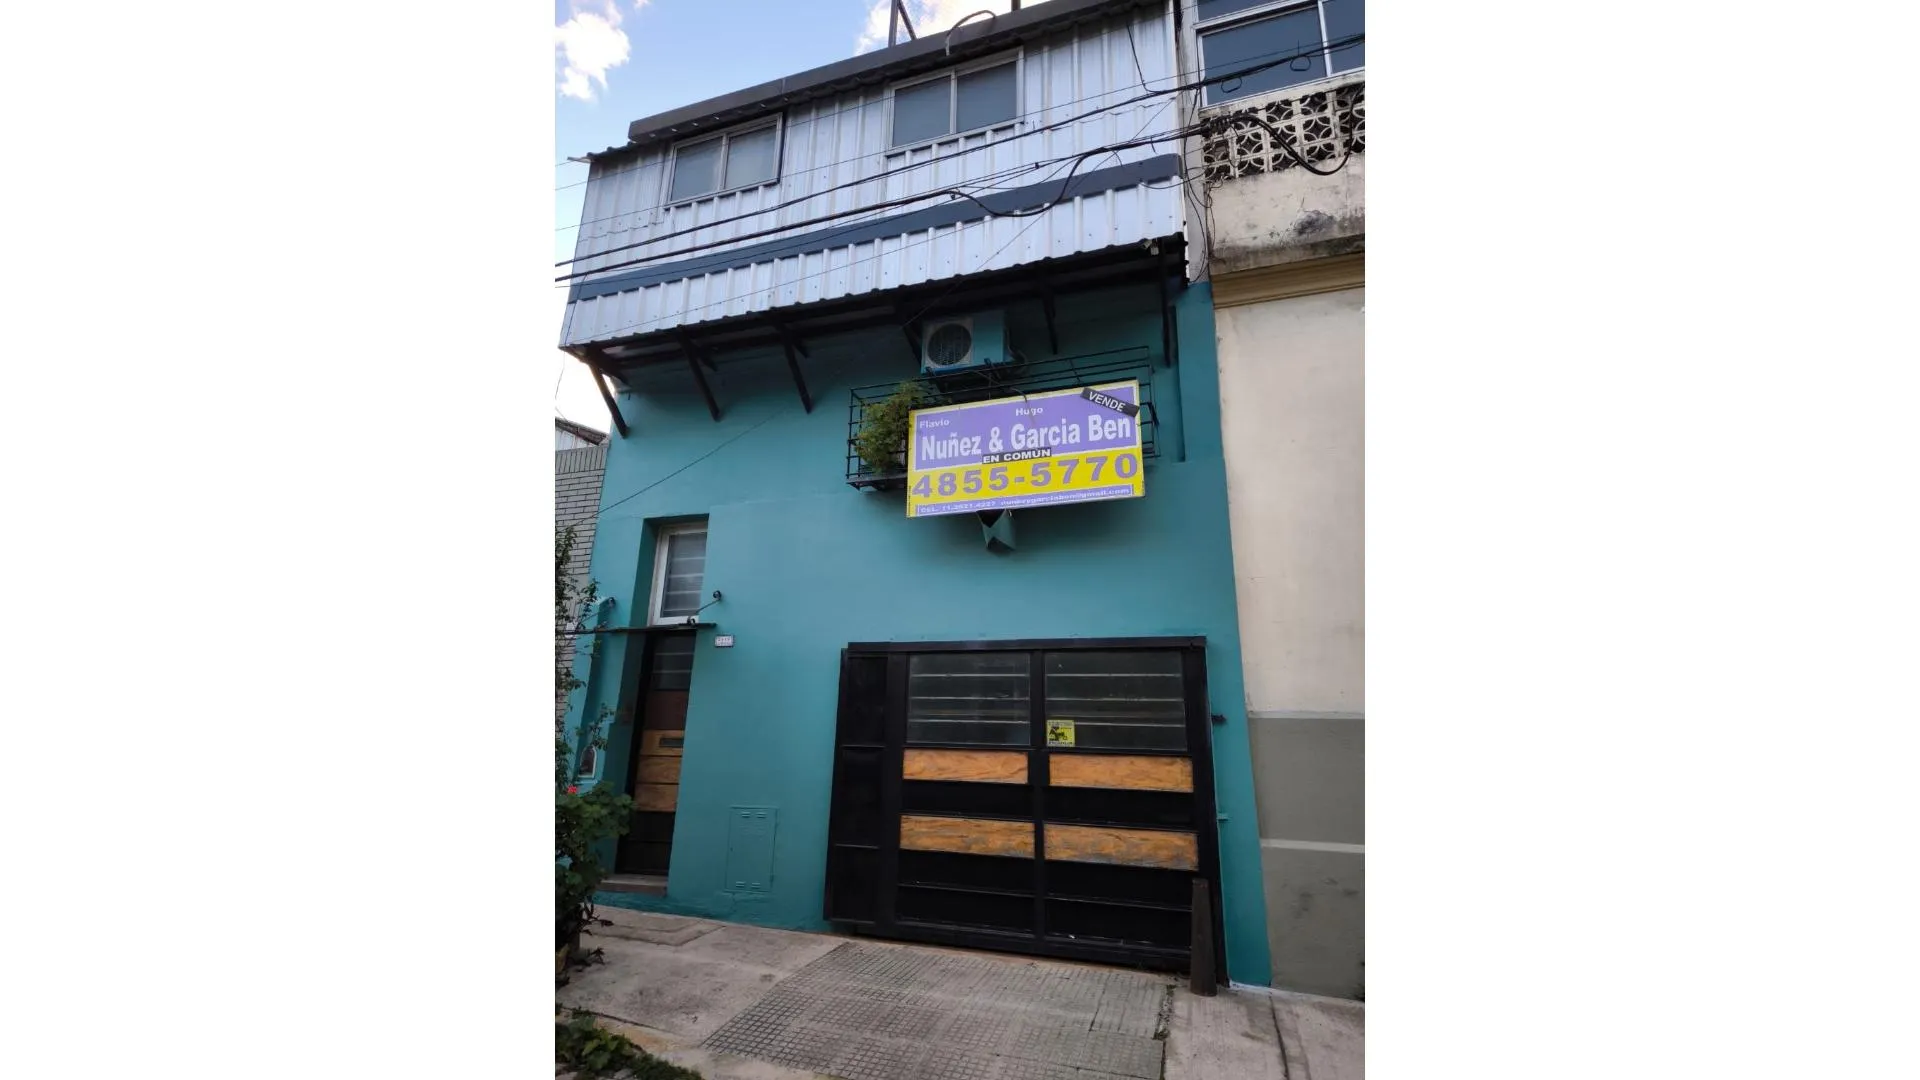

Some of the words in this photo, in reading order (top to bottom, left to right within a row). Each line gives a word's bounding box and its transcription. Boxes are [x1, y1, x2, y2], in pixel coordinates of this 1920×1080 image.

[1088, 391, 1126, 412] VENDE
[1015, 406, 1043, 418] Hugo
[919, 418, 950, 429] Flavio
[921, 432, 982, 461] Nuñez
[988, 426, 1003, 453] &
[1010, 418, 1081, 451] Garcia
[1088, 414, 1131, 442] Ben
[983, 455, 1000, 464] EN
[1003, 448, 1051, 462] COMÚN
[912, 453, 1138, 498] 4855-5770
